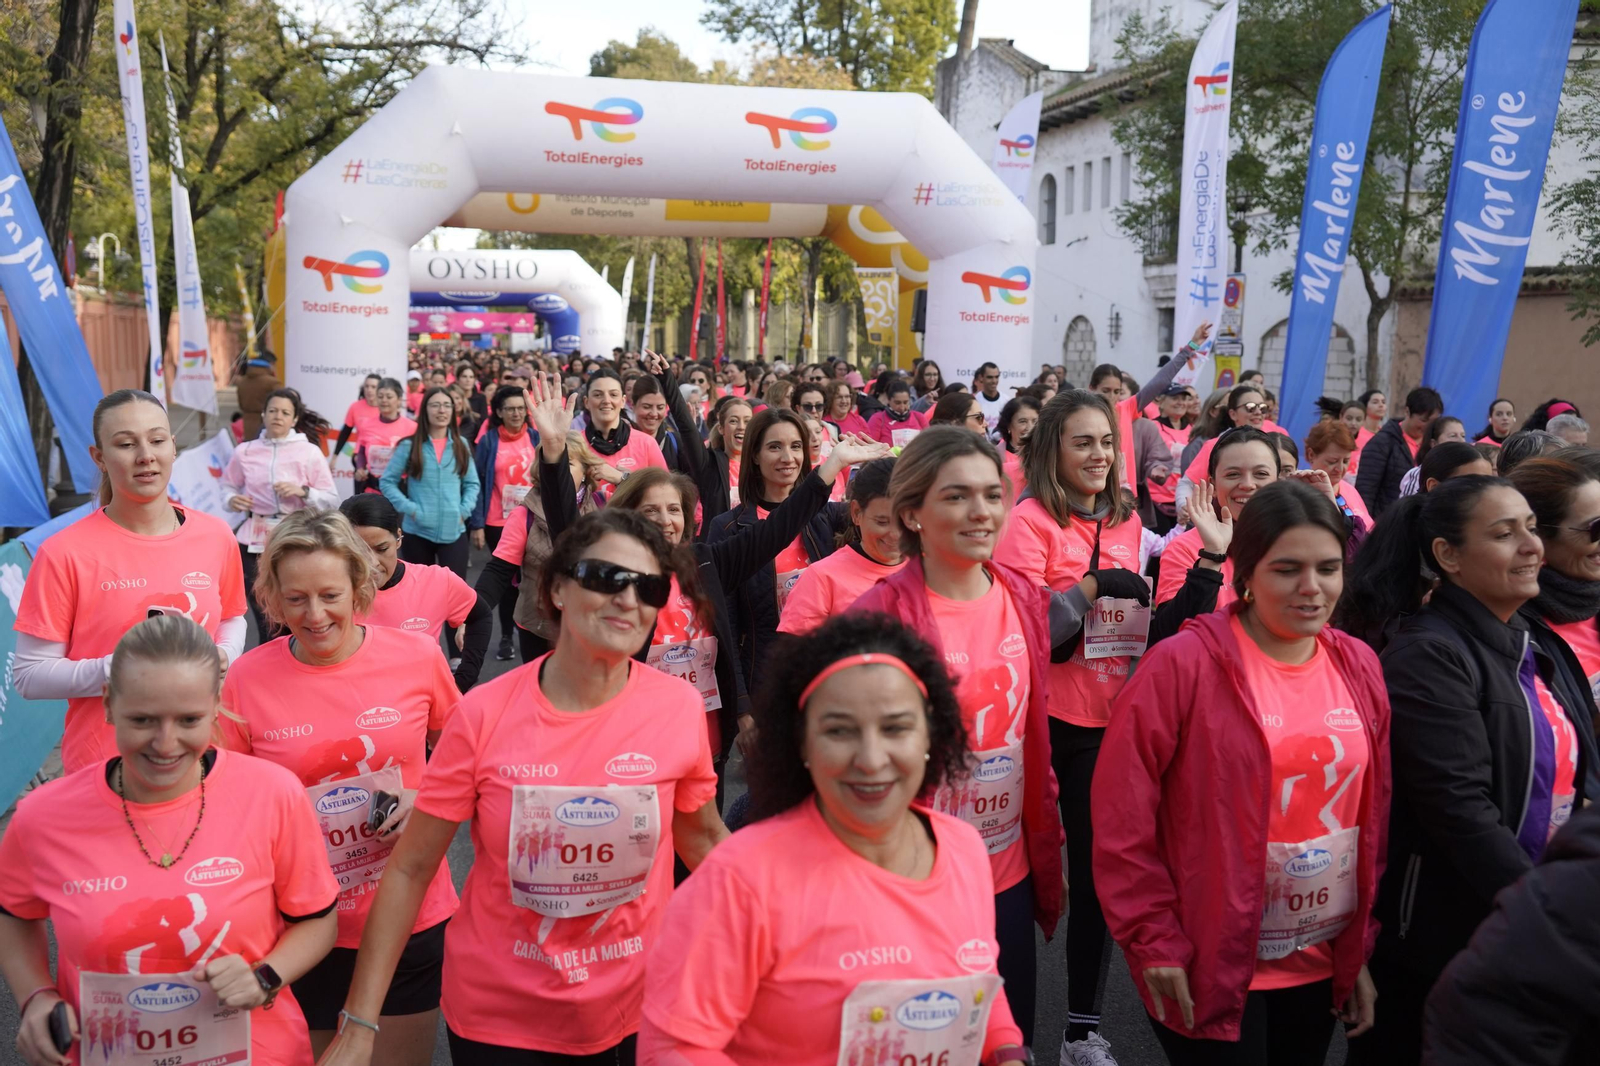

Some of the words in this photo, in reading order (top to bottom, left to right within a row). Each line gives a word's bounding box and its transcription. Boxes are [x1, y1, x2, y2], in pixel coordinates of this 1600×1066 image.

[544, 150, 644, 168] TotalEnergies
[744, 158, 837, 174] TotalEnergies
[1450, 90, 1536, 286] Marlene
[570, 207, 584, 216] de
[587, 207, 634, 218] Deportes
[1300, 140, 1360, 304] Marlene
[428, 257, 538, 280] OYSHO
[302, 301, 389, 317] TotalEnergies
[959, 312, 1030, 326] TotalEnergies
[300, 364, 386, 376] totalenergies.es
[101, 578, 147, 591] OYSHO
[1101, 610, 1124, 623] 016
[945, 652, 969, 665] SHO
[360, 714, 399, 726] ASTURIANA
[264, 724, 313, 742] OYSHO
[499, 764, 558, 778] OYSHO
[610, 762, 653, 773] ASTURIANA
[976, 765, 1012, 777] ASTURIANA
[321, 794, 366, 811] ASTURIANA
[974, 792, 1009, 814] 016
[522, 811, 552, 819] SUMA
[561, 808, 615, 819] ASTURIANA
[982, 818, 998, 828] 6426
[328, 821, 375, 846] 016
[346, 847, 368, 859] 3453
[560, 843, 614, 864] 016
[357, 856, 375, 867] MUJER
[1289, 858, 1329, 872] ASTURIANA
[190, 868, 240, 881] ASTURIANA
[573, 873, 598, 882] 6425
[62, 875, 127, 896] OYSHO
[351, 884, 365, 896] LA
[608, 879, 632, 890] SEVILLA
[336, 899, 355, 910] 2025
[526, 897, 569, 910] OYSHO
[1288, 887, 1329, 912] 016
[563, 950, 580, 969] DE
[582, 947, 598, 964] LA
[601, 936, 643, 962] MUJER
[1258, 942, 1292, 953] OYSHO
[839, 946, 912, 971] OYSHO
[567, 967, 589, 984] 2025
[93, 996, 123, 1004] SUMA
[133, 993, 195, 1006] ASTURIANA
[902, 1006, 958, 1021] ASTURIANA
[136, 1025, 198, 1050] 016
[153, 1056, 182, 1066] 3452
[900, 1050, 950, 1066] 016
